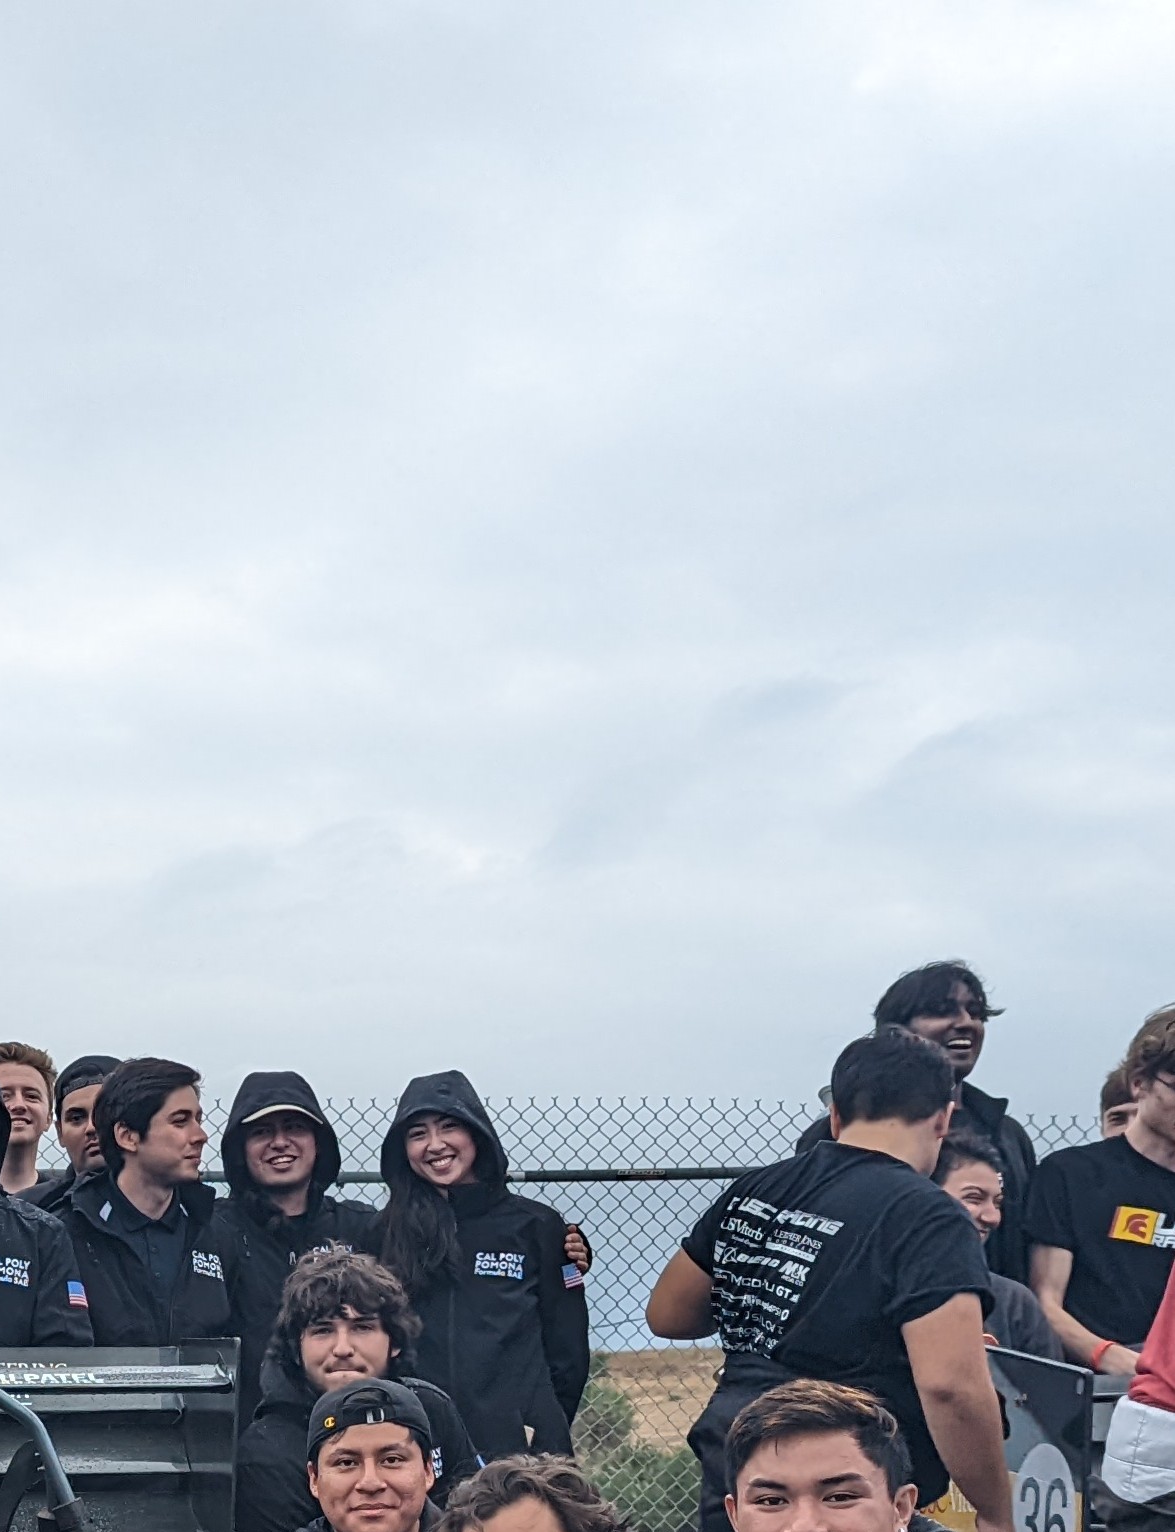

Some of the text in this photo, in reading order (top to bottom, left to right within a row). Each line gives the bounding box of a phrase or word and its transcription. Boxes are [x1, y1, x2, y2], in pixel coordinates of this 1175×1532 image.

[192, 1250, 208, 1261] CAL
[476, 1251, 525, 1264] CAL POLY
[5, 1257, 31, 1270] POLY
[474, 1259, 524, 1272] POMONA
